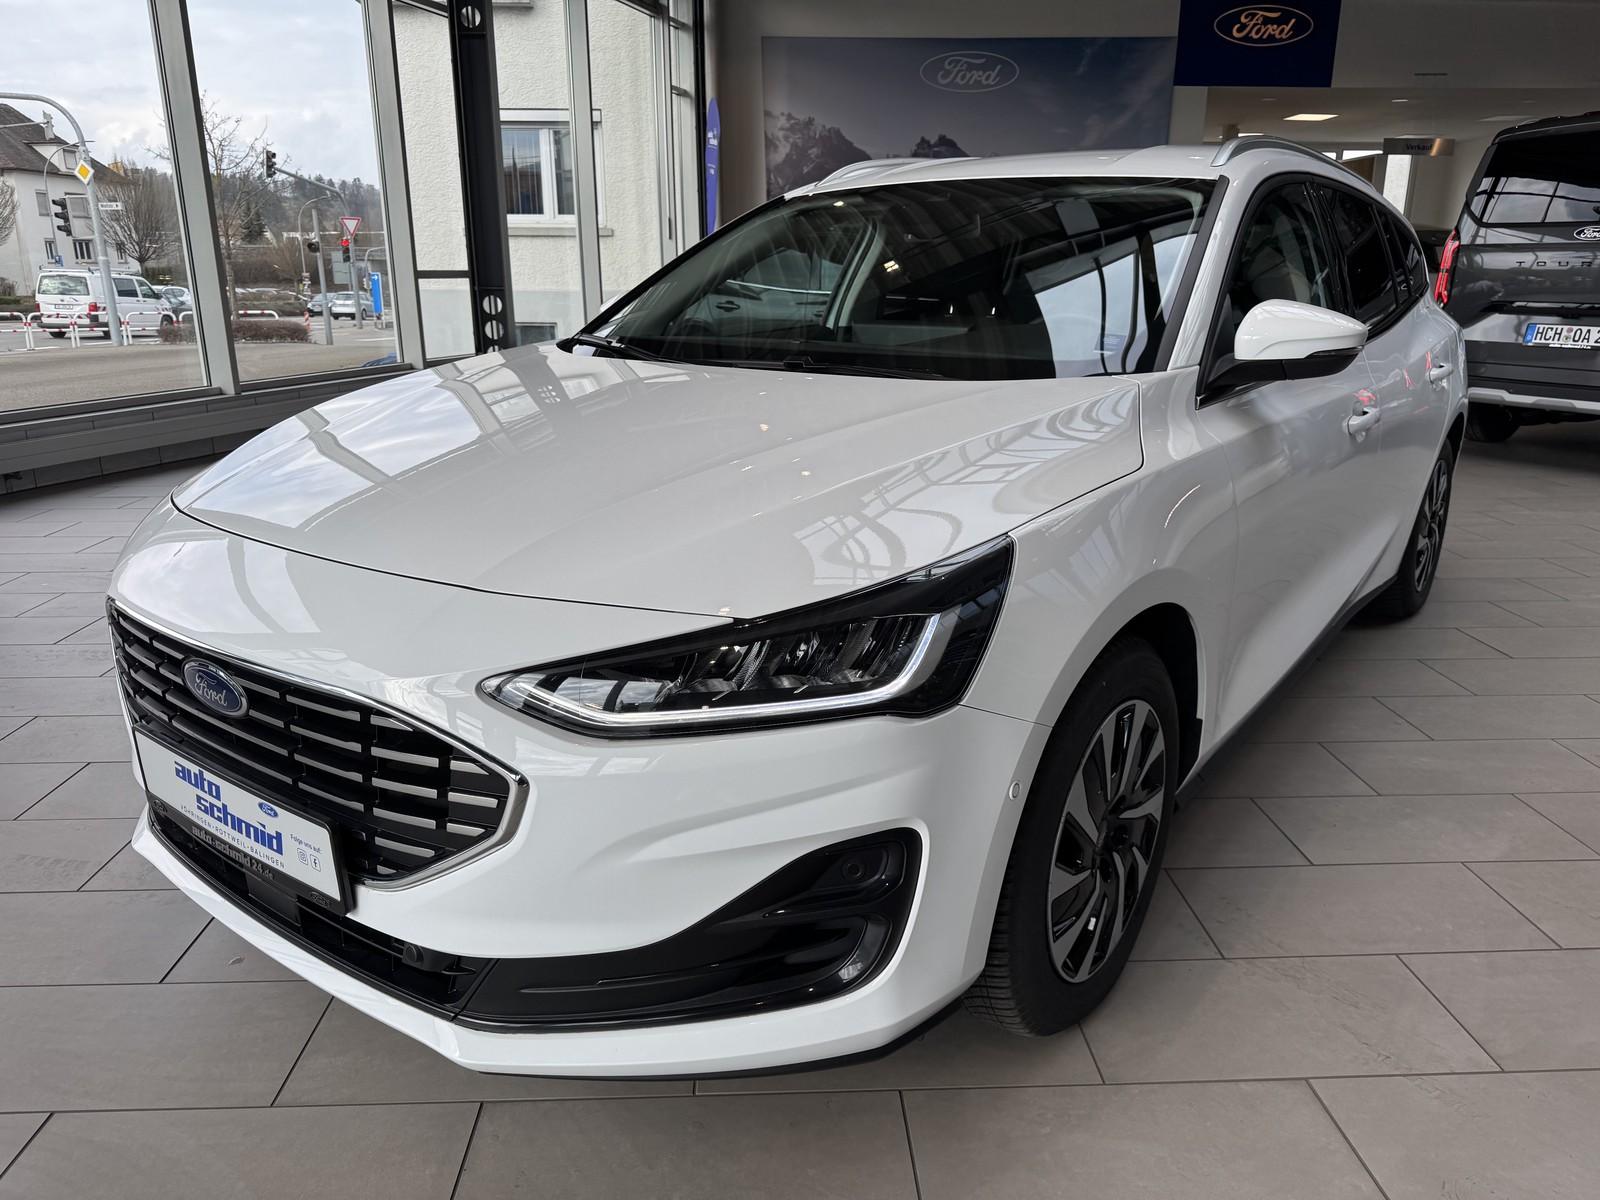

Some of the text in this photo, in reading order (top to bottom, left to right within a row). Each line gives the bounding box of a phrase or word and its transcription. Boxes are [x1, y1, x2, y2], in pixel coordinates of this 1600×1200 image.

[1232, 10, 1297, 39] Ford
[937, 56, 1003, 85] Ford
[1534, 326, 1564, 342] HCH
[1572, 327, 1592, 344] OA
[194, 671, 229, 707] Ford
[174, 760, 222, 802] auto
[196, 794, 284, 856] schmid
